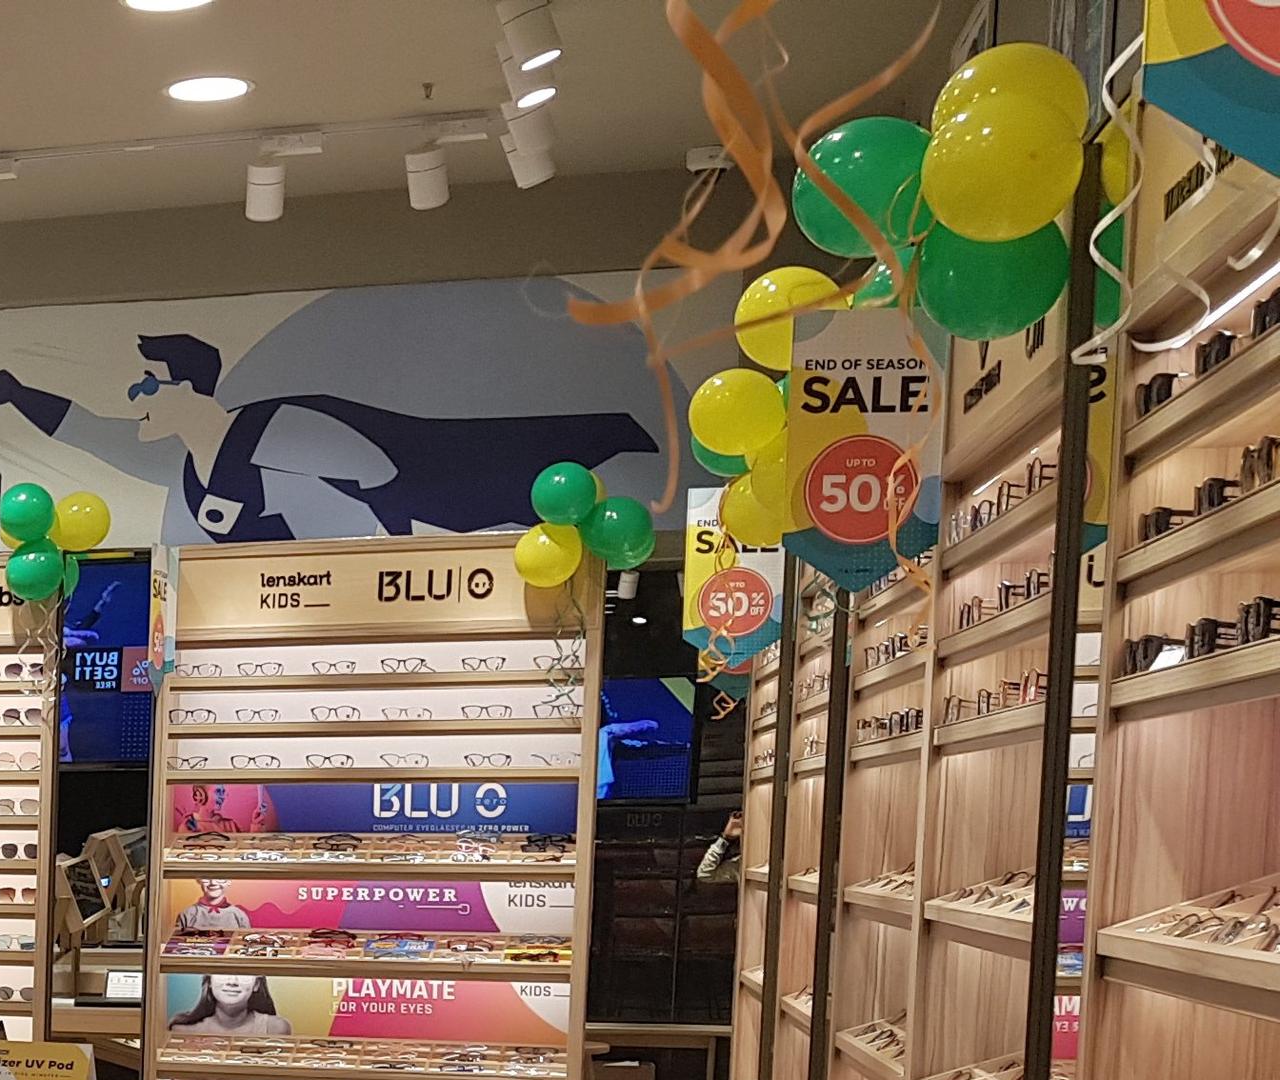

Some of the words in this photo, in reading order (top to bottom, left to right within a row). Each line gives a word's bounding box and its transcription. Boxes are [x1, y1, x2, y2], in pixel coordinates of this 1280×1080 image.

[805, 359, 837, 371] END
[841, 359, 861, 370] OF
[801, 375, 929, 413] SALE
[697, 519, 719, 527] END
[260, 570, 331, 588] lenskart
[378, 569, 453, 602] BLU
[260, 593, 301, 609] KIDS
[373, 783, 459, 818] BLU
[373, 824, 414, 832] COMPUTER
[416, 824, 466, 832] EYEGLASSES
[478, 824, 499, 832] ZERO
[298, 887, 458, 902] SUPERPOWER
[508, 895, 546, 908] KIDS
[332, 978, 456, 1000] PLAYMATE
[519, 985, 552, 997] KIDS
[332, 1001, 357, 1013] FOR
[362, 1002, 396, 1014] YOUR
[400, 1003, 433, 1015] EYES
[25, 1059, 45, 1069] UV
[48, 1060, 74, 1071] Pod
